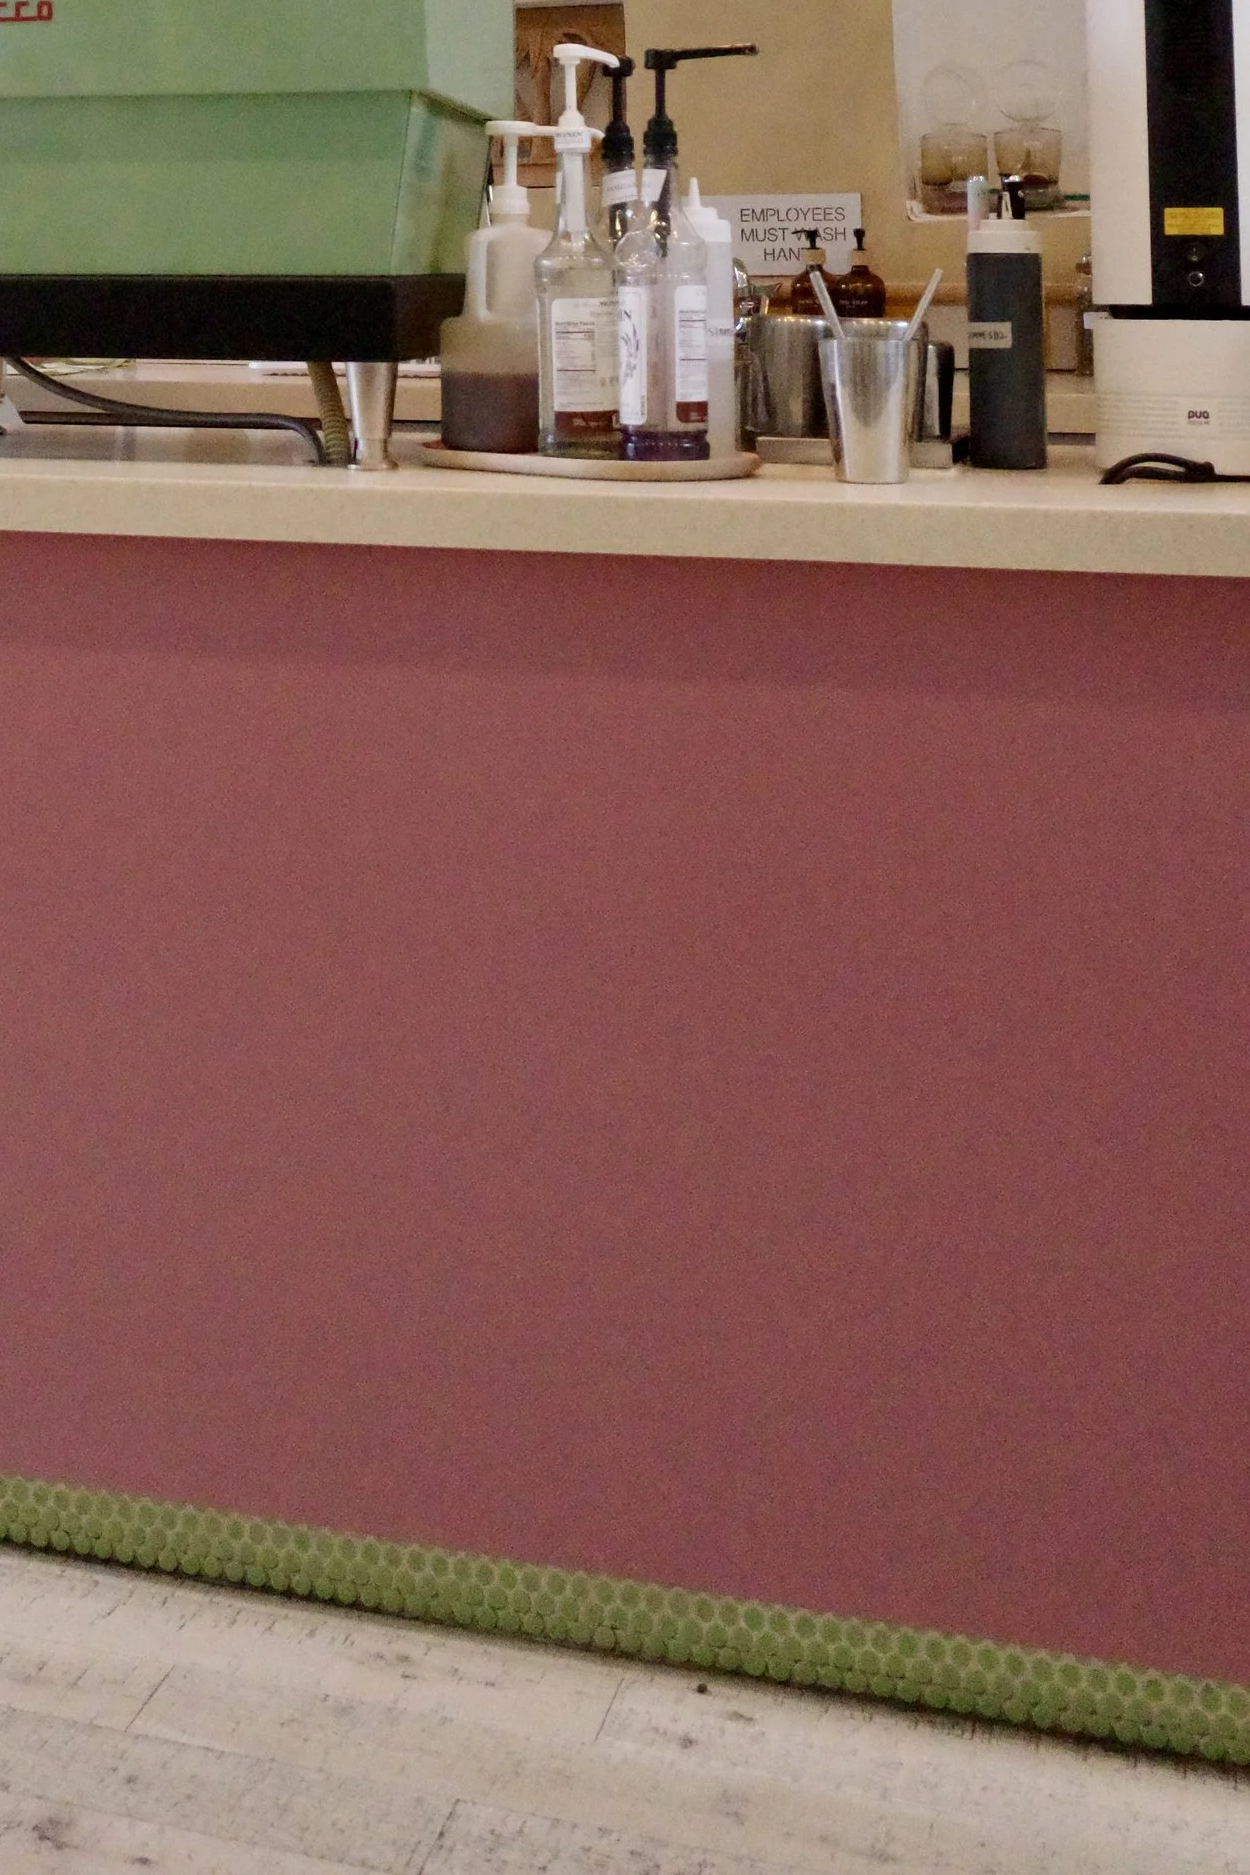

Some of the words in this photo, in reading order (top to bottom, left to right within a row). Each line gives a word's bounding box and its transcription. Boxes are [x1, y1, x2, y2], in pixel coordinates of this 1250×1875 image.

[739, 206, 846, 223] EMPLOYEES
[740, 227, 789, 243] MUST
[763, 247, 801, 262] HAN
